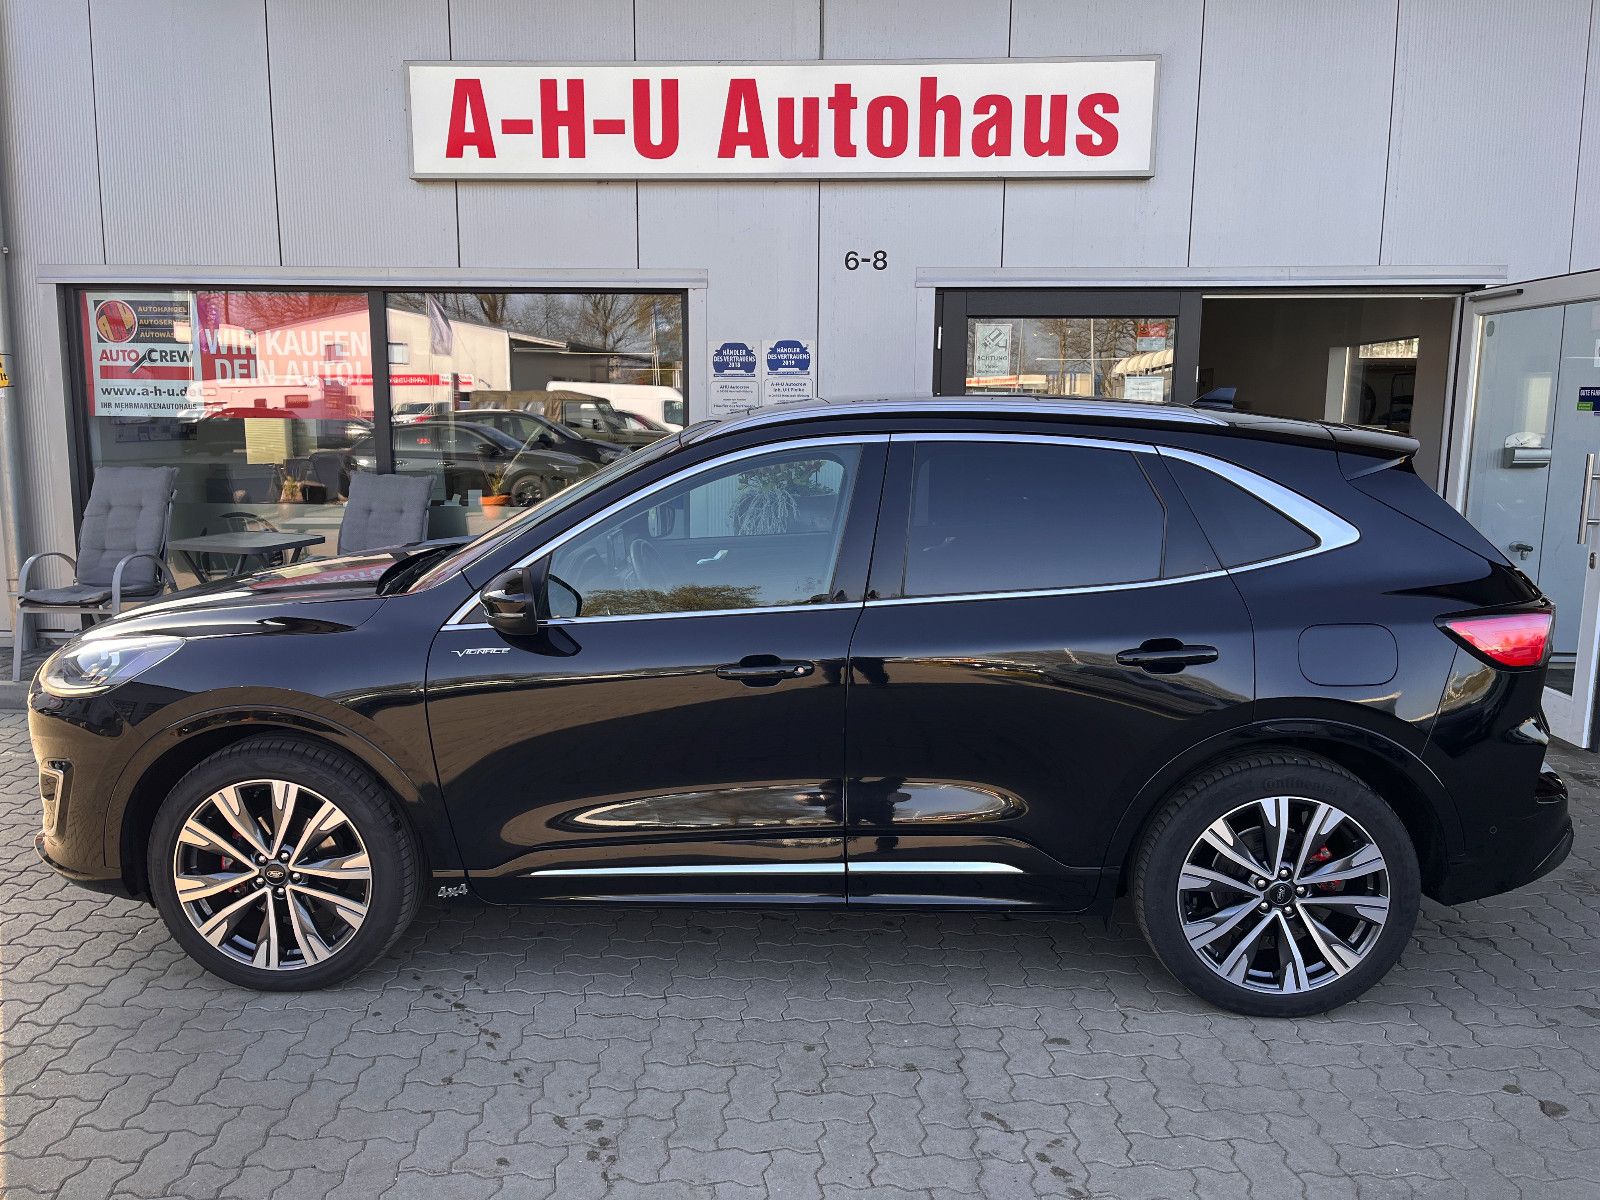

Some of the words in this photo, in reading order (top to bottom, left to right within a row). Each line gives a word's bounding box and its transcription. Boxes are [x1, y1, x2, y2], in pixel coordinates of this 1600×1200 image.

[446, 78, 680, 159] A-H-U
[717, 76, 1120, 158] Autohaus
[845, 250, 888, 270] 6-8
[205, 329, 257, 355] WIR
[265, 330, 368, 357] KAUFEN
[215, 359, 276, 386] DEIN
[286, 359, 364, 387] AUTO!
[114, 402, 198, 410] MEHRMARKENAUTOHAUS
[438, 883, 467, 898] 4x4
